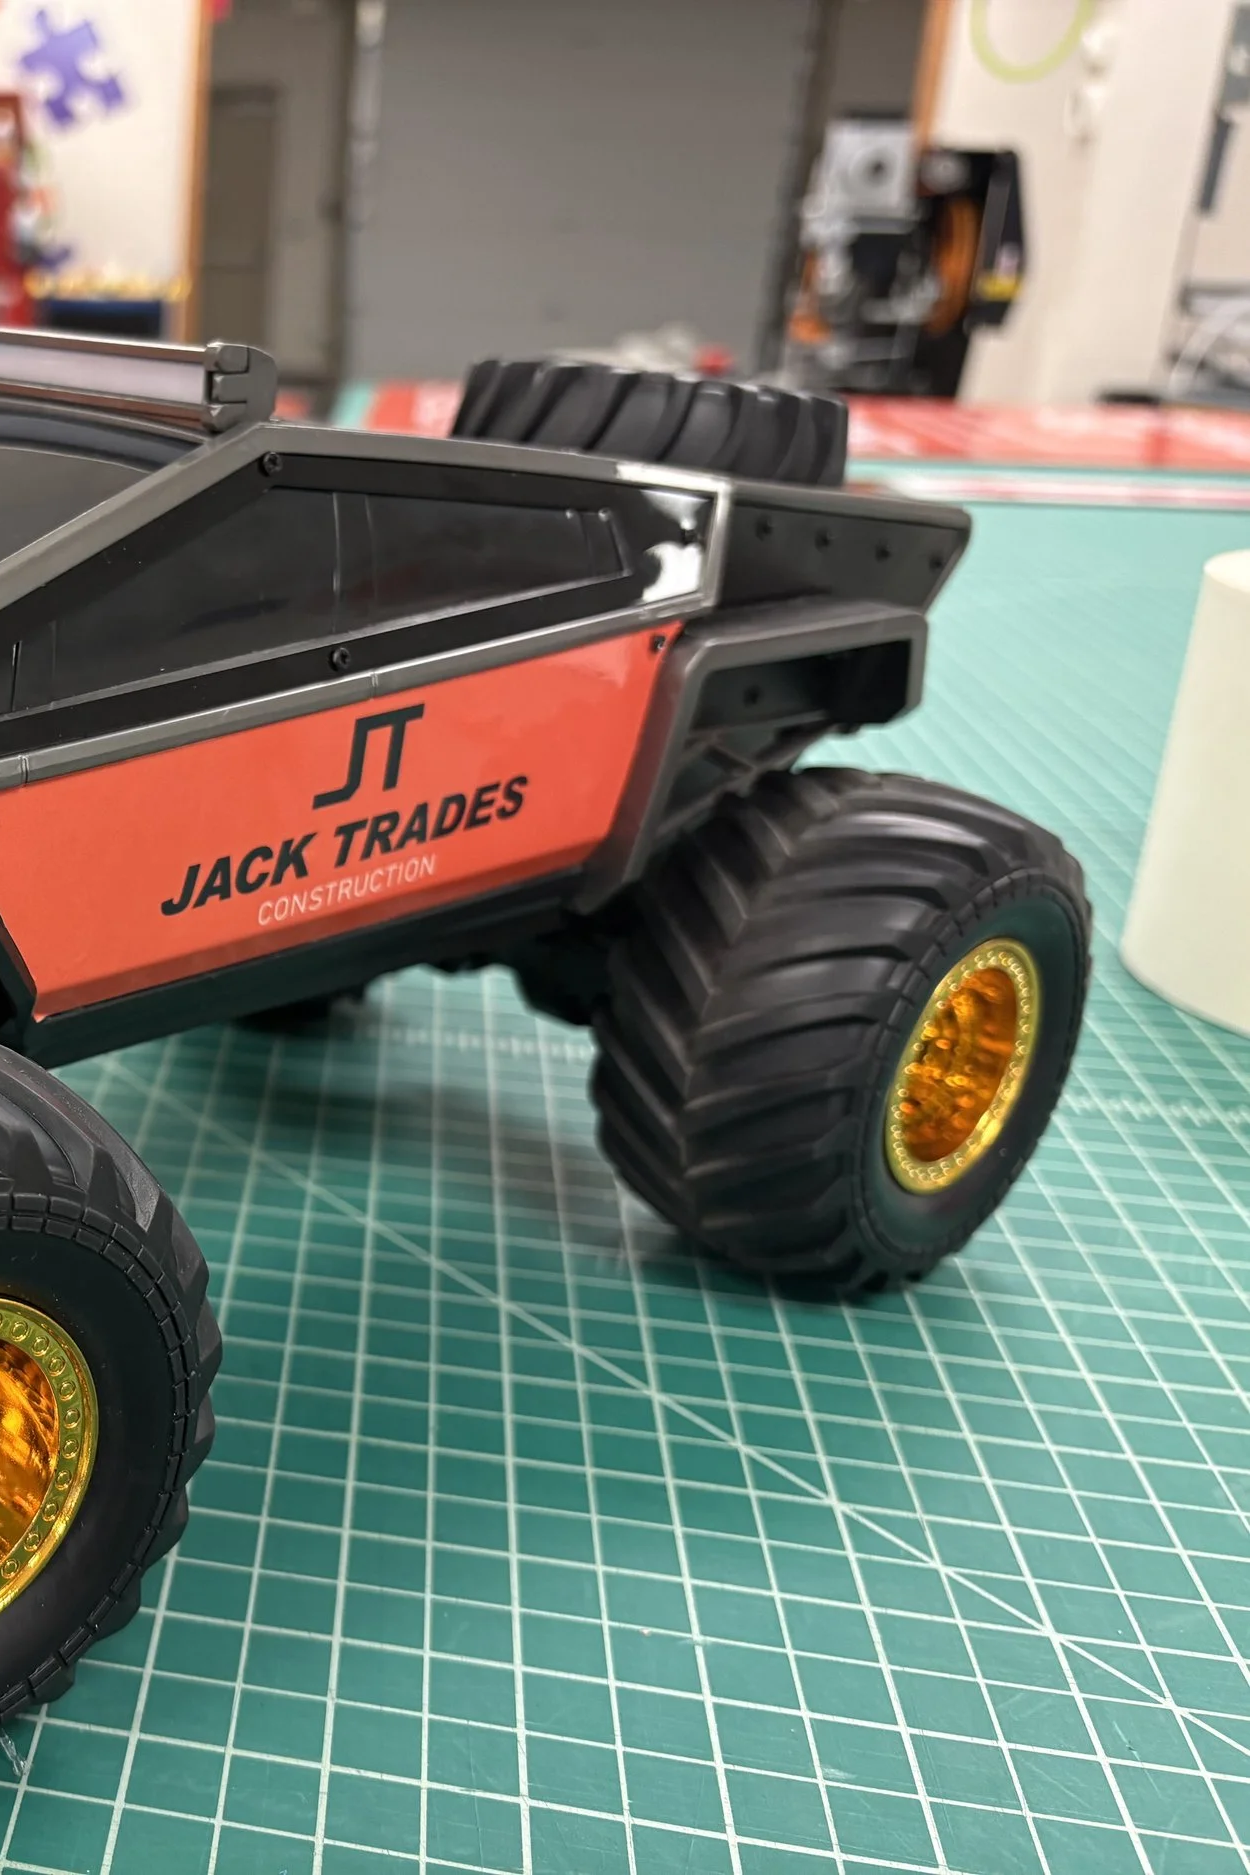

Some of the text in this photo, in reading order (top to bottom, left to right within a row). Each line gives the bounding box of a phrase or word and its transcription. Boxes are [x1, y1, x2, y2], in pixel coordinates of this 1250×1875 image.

[311, 702, 426, 811] JT
[160, 774, 529, 917] JACK TRADES
[257, 853, 437, 926] CONSTRUCTION
